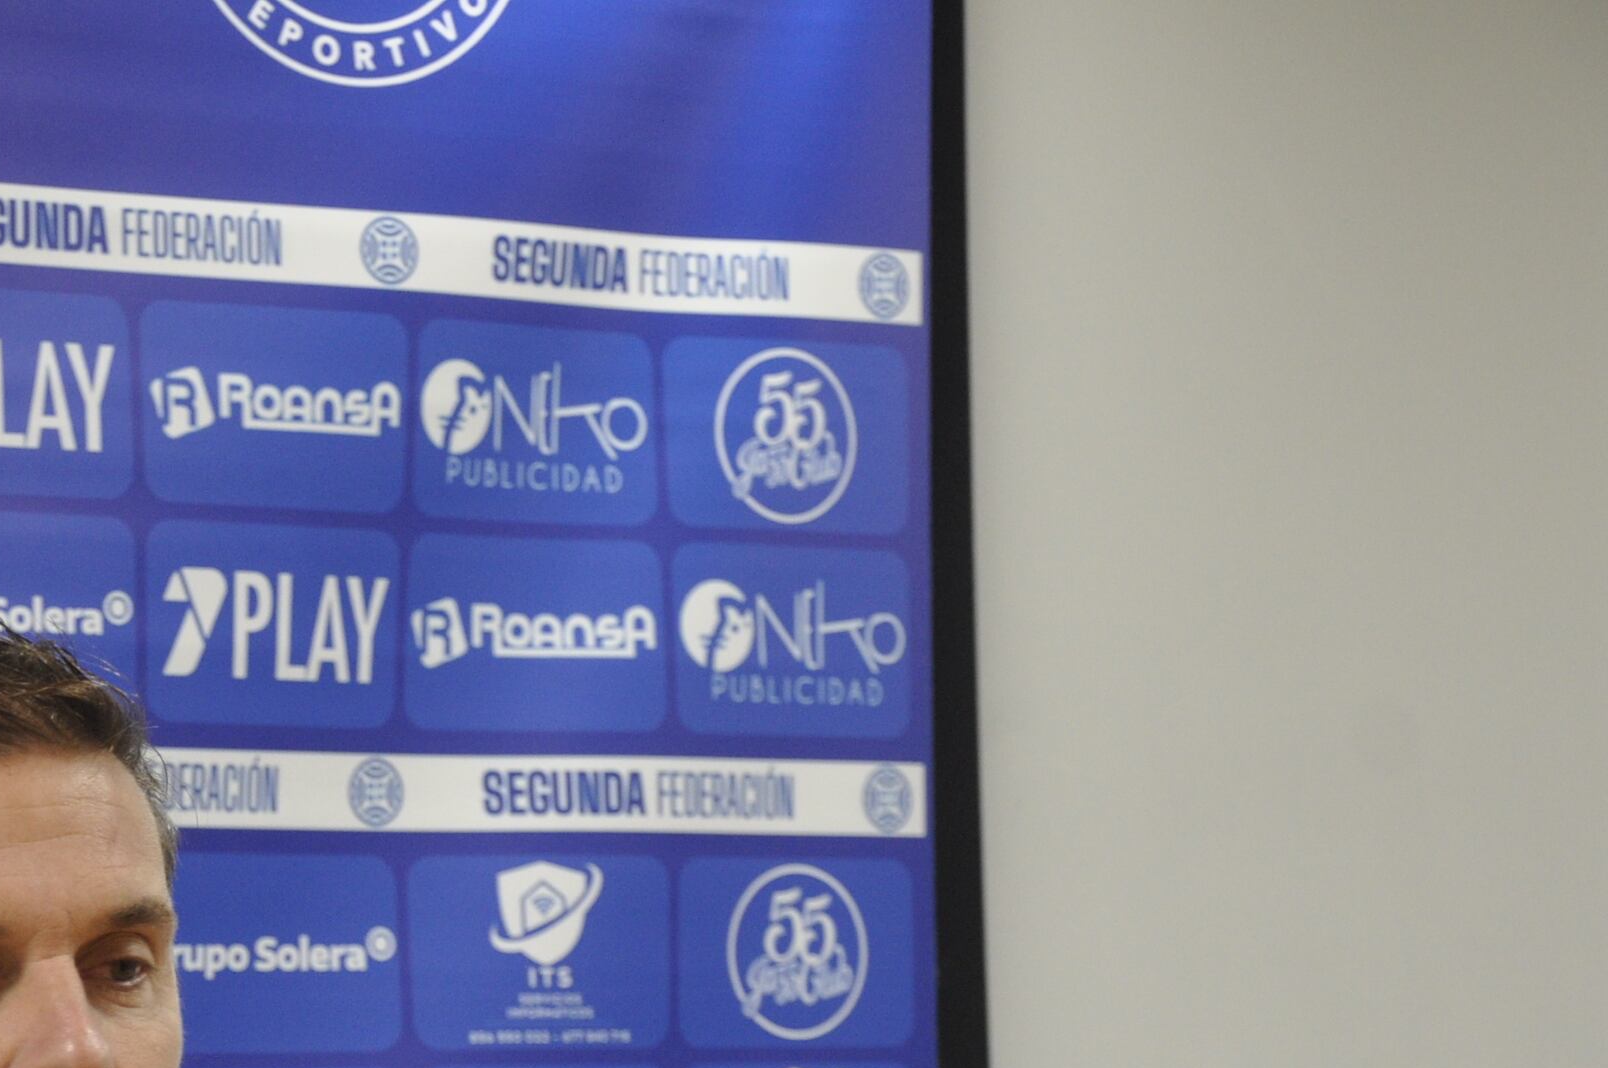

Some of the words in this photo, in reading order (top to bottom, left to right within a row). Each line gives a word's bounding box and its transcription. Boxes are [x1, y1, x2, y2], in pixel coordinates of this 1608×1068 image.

[247, 0, 487, 71] EPORTIVO
[121, 208, 282, 266] FEDERACIÓN
[493, 235, 627, 292] SEGUNDA
[639, 249, 789, 300] FEDERACIÓN
[754, 371, 825, 449] 55
[446, 456, 623, 494] PUBLICIDAD
[711, 675, 884, 707] PUBLICIDAD
[483, 771, 645, 815] SEGUNDA
[658, 771, 793, 818] FEDERACIÓN
[763, 887, 837, 966] 55
[173, 943, 250, 980] rupo
[255, 934, 368, 971] Solera
[527, 966, 574, 988] ITS
